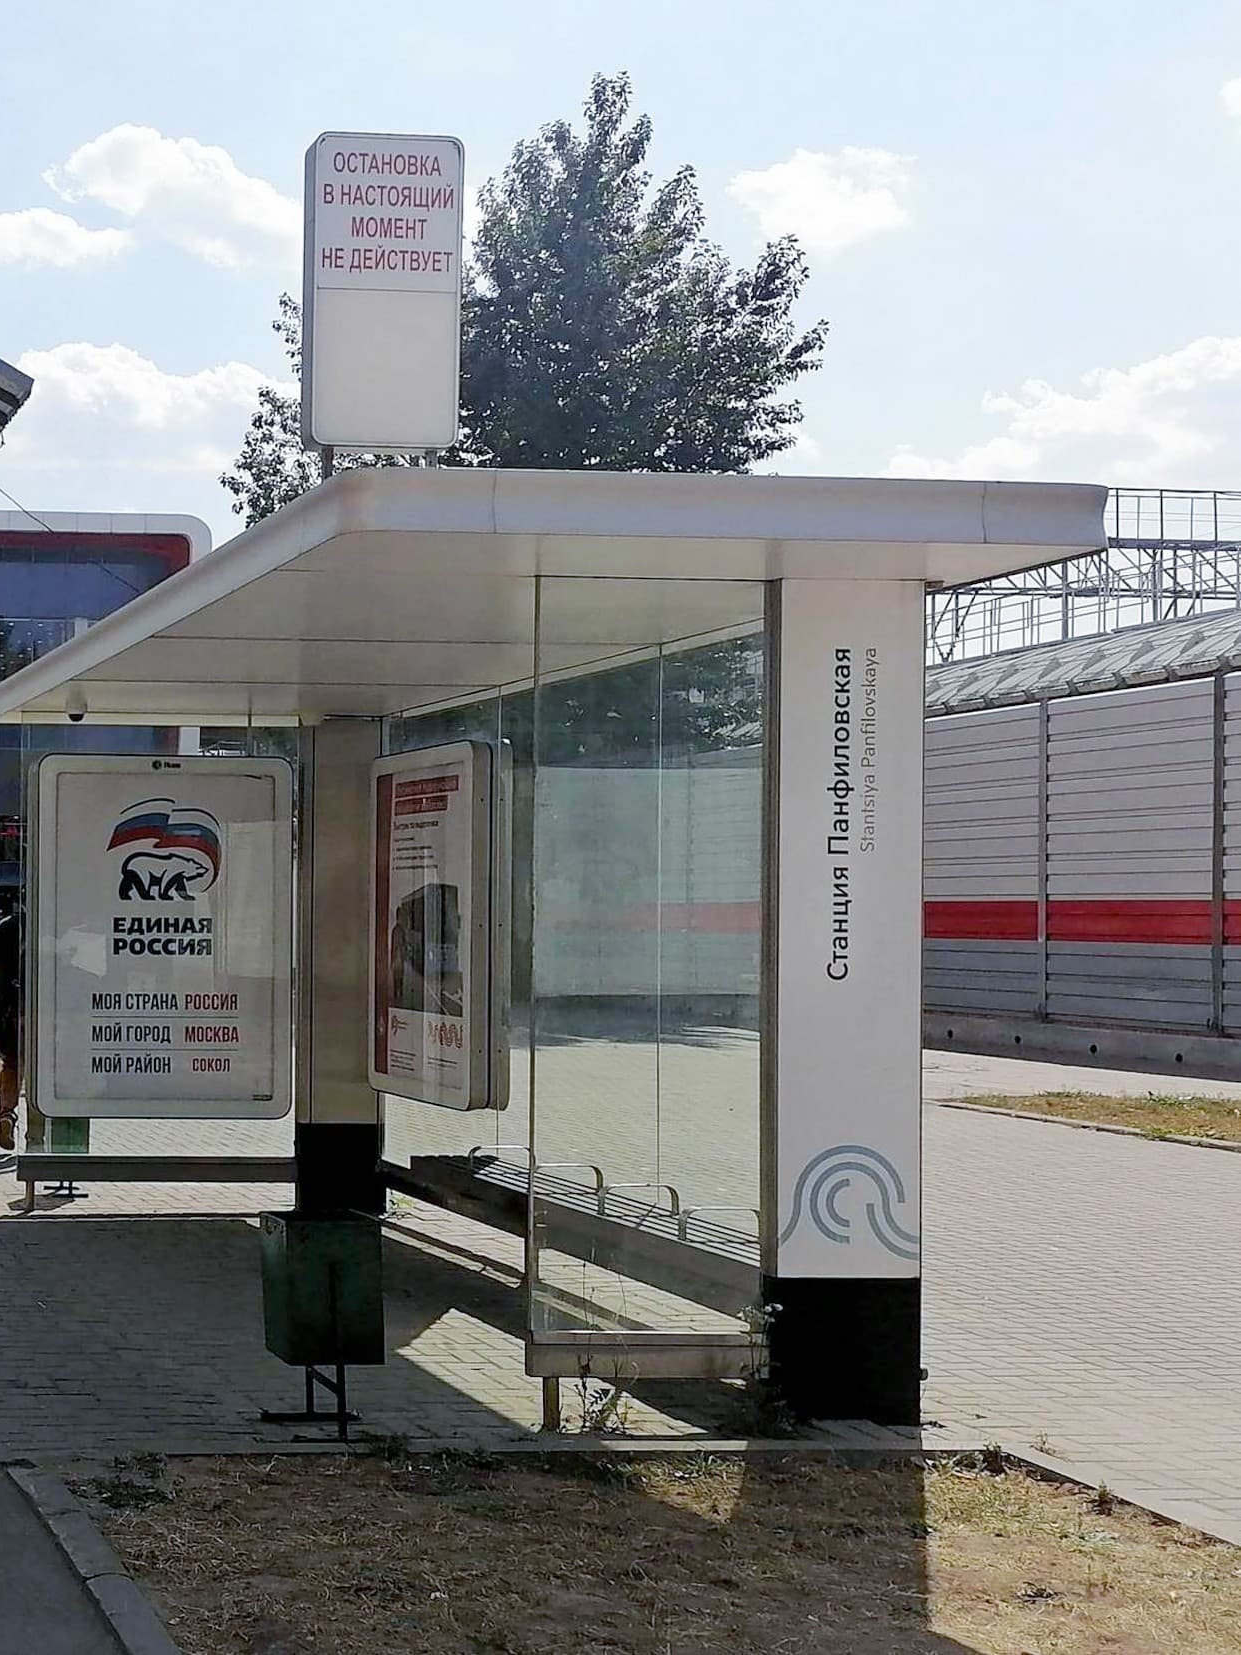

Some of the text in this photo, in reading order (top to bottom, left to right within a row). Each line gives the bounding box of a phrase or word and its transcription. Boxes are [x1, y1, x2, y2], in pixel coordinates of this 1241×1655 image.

[333, 152, 442, 177] ОСТАНОВКА
[323, 182, 455, 212] В НАСТОЯЩИЙ
[351, 216, 428, 240] МОМЕНТ
[321, 244, 454, 273] НЕ ДЕЙСТВУЕТ
[860, 647, 880, 768] Panfilovskaya
[827, 648, 855, 980] Станция Панфиловская
[113, 917, 212, 935] ЕДИНАЯ
[113, 938, 212, 955] РОССИЯ
[92, 993, 238, 1010] МОЯ СТРАНА РОССИЯ
[92, 1022, 239, 1044] МОЙ ГОРОД МОСКВА
[92, 1053, 230, 1073] МОЙ РАЙОН СОКОЛ
